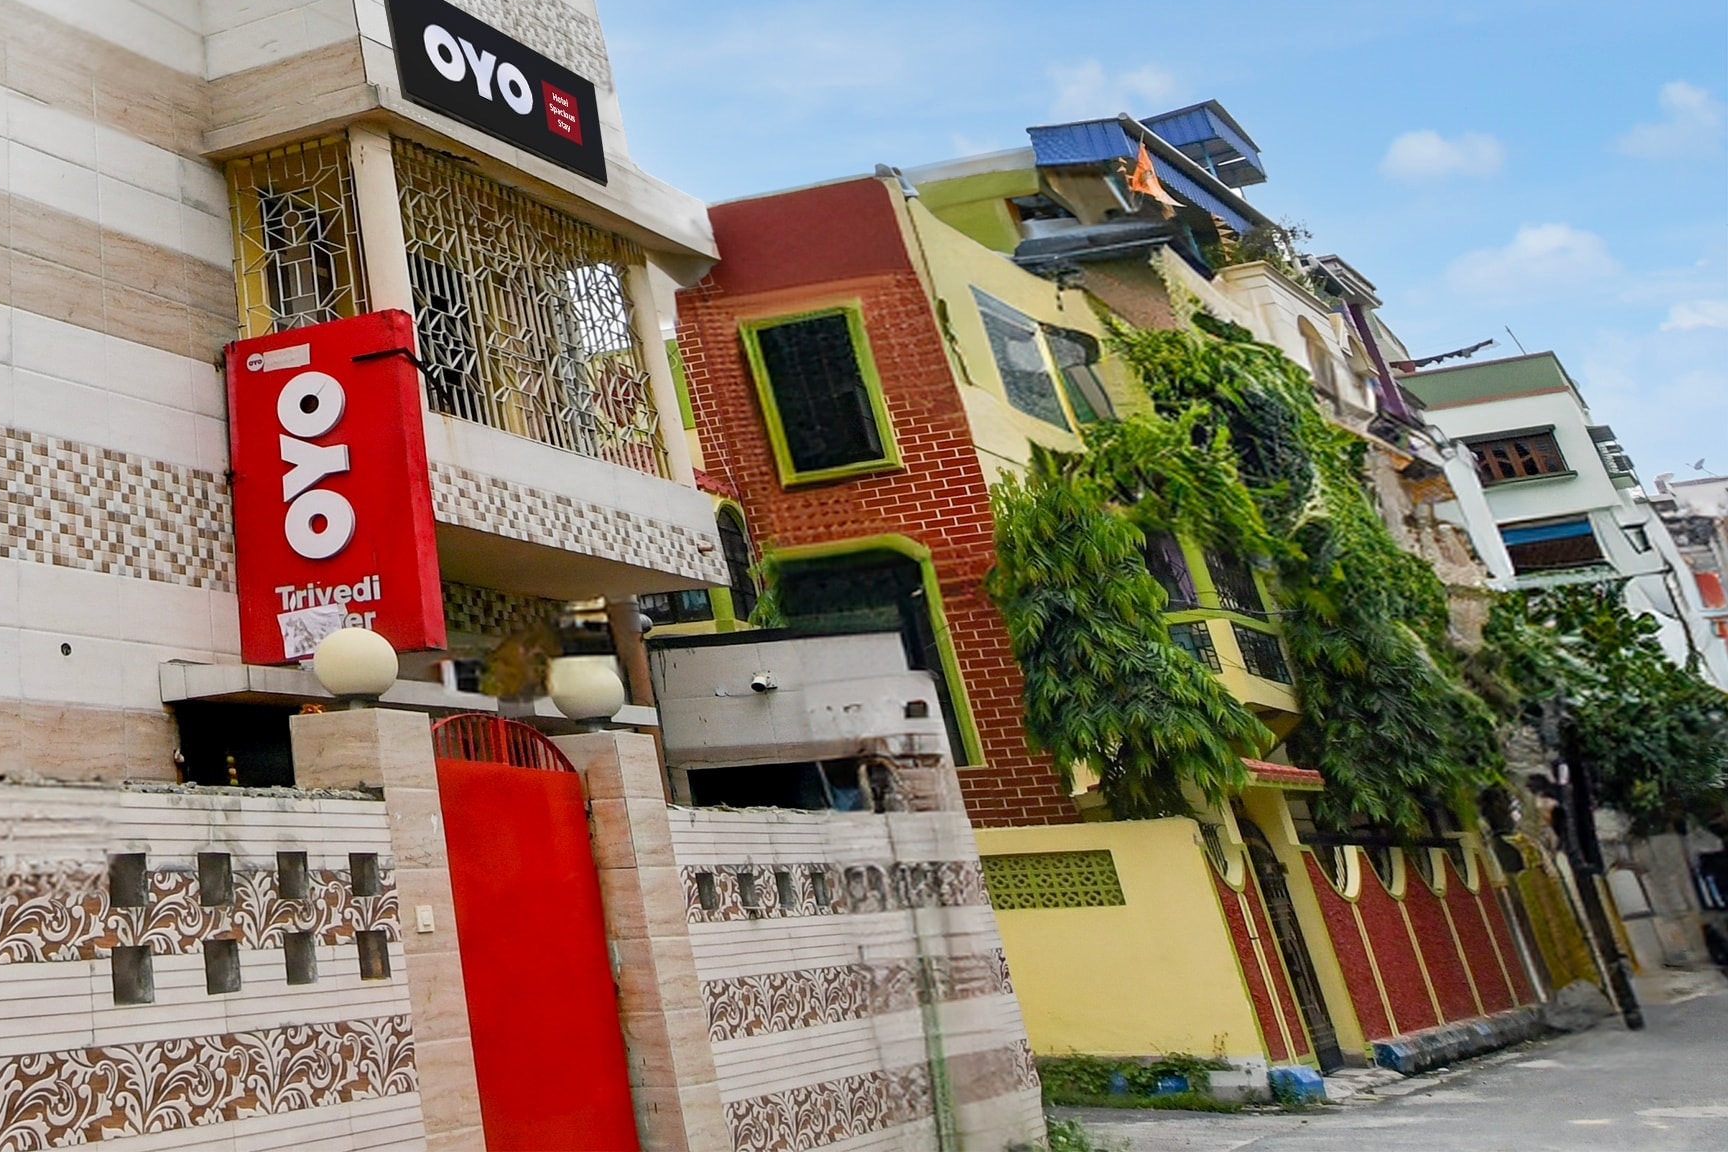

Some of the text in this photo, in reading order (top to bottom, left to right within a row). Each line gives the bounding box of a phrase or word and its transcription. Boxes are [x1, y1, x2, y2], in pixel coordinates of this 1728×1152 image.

[423, 24, 533, 115] OYO
[552, 92, 569, 107] Hotel
[549, 103, 576, 122] Spacious
[557, 119, 571, 133] Stay
[248, 359, 263, 367] OYO
[277, 371, 356, 559] OYO
[275, 575, 381, 611] Trivedi
